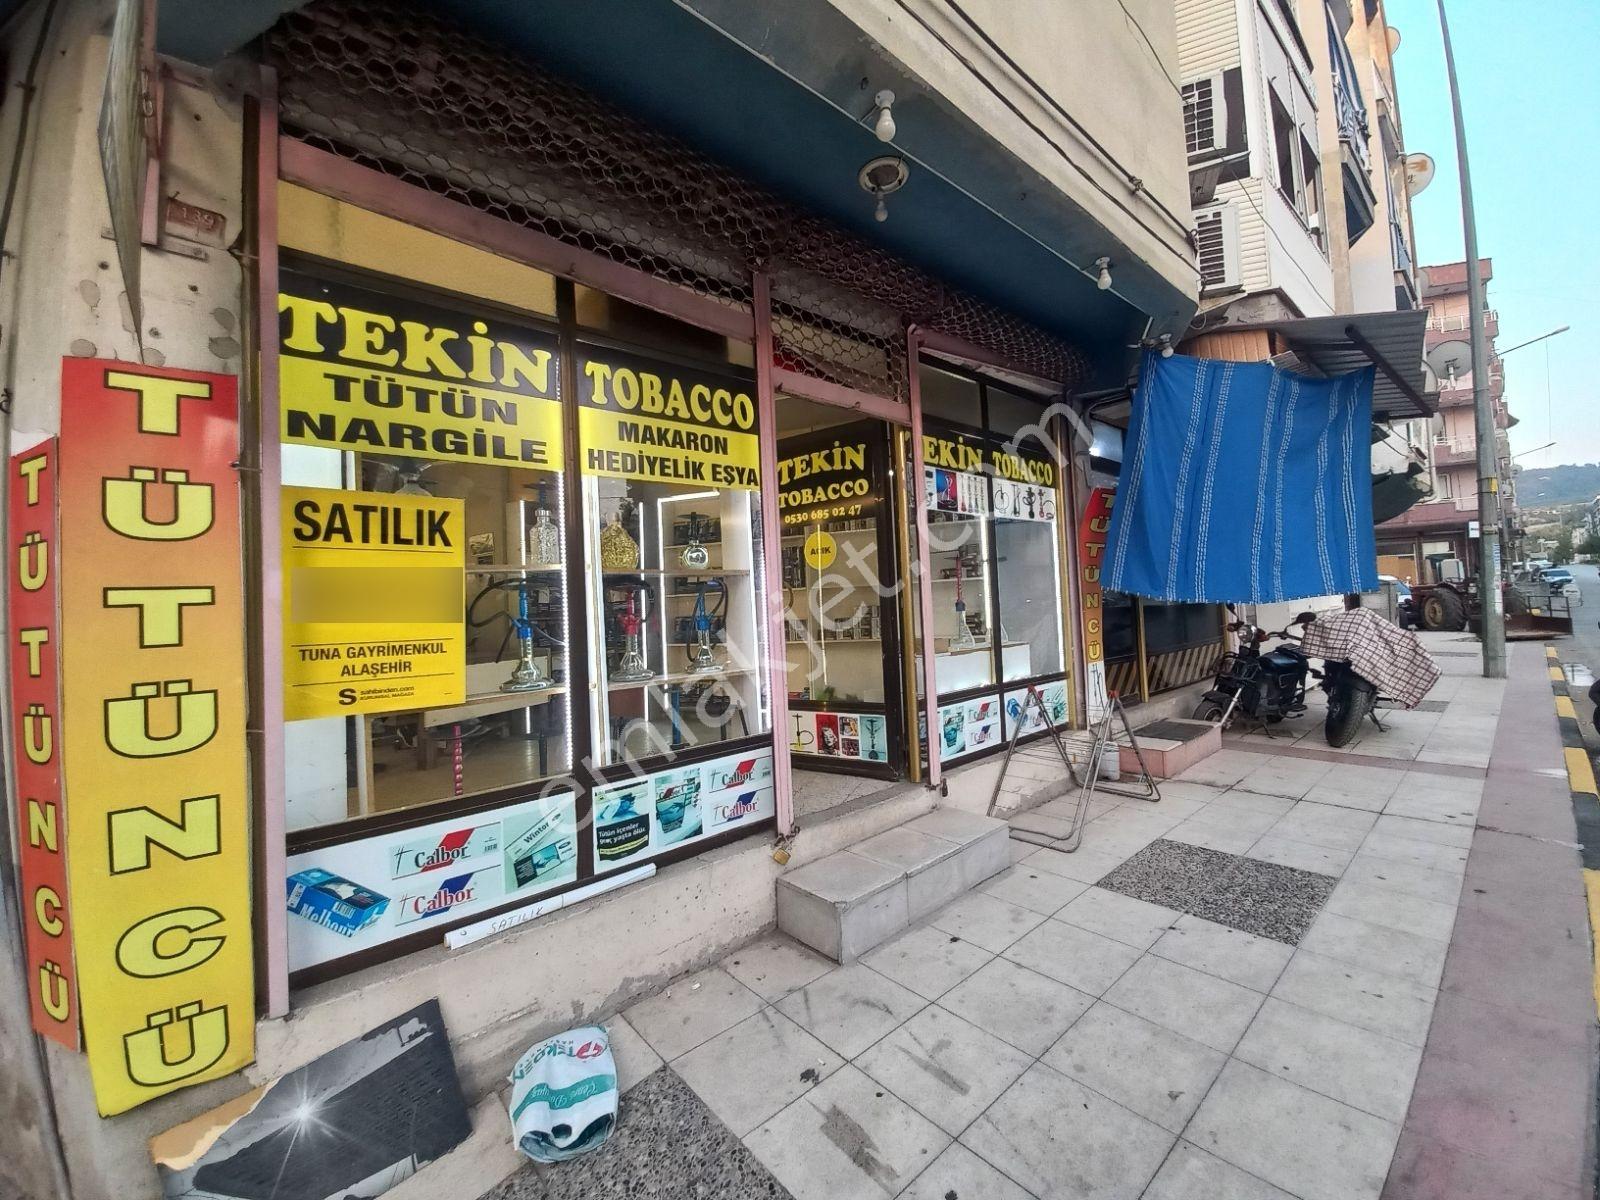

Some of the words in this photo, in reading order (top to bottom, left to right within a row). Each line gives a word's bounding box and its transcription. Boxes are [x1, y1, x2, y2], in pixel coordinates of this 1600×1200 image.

[278, 292, 552, 393] TEKİN
[323, 372, 518, 426] TÜTÜN
[585, 361, 754, 430] TOBACCO
[287, 410, 549, 465] NARGİLE
[618, 421, 729, 456] MAKARON
[905, 430, 983, 473] EKİN
[588, 448, 706, 481] HEDİYELİK
[711, 464, 759, 487] EŞYA
[776, 440, 866, 486] TEKİN
[992, 450, 1053, 486] TOBACCO
[778, 478, 870, 509] TOBACCO
[293, 500, 453, 547] SATILIK
[784, 512, 808, 524] 0530
[832, 507, 846, 516] 02
[848, 504, 862, 516] 47
[300, 648, 341, 661] TUNA
[347, 642, 447, 659] GAYRİMENKUL
[340, 659, 412, 678] ALAŞEHİR
[20, 454, 70, 1023] TÜTÜNCÜ
[102, 368, 230, 1087] TÜTÜNCÜ
[722, 800, 758, 819] Calbor
[414, 845, 469, 869] Calbor
[414, 887, 475, 915] Calbor
